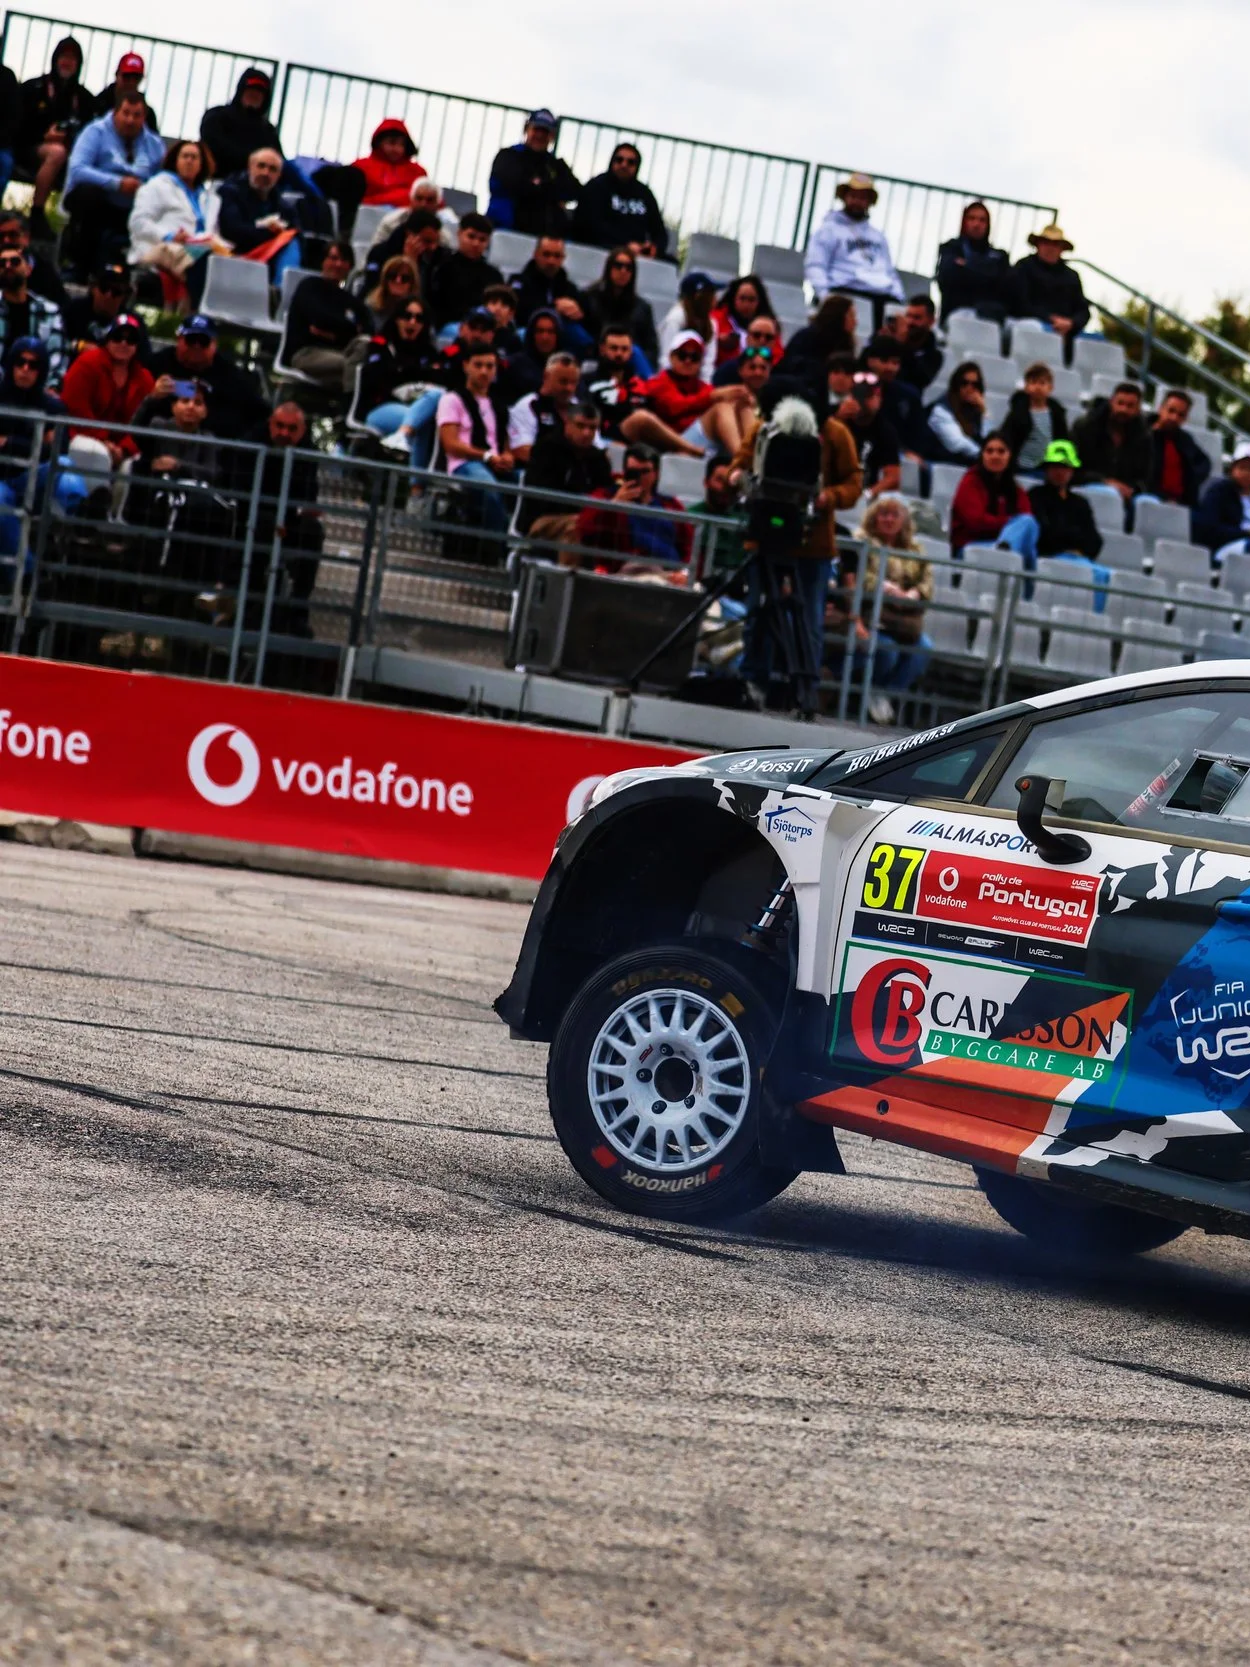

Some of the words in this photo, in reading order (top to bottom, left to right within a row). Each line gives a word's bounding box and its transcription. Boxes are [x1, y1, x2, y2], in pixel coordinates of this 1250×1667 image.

[754, 761, 793, 773] Forss
[793, 758, 815, 773] IT
[272, 756, 473, 816] vodafone
[772, 818, 813, 838] Sjötorps
[784, 833, 797, 843] Hus
[928, 824, 1040, 854] ALMASPOR
[863, 844, 925, 910] 37
[982, 873, 1007, 885] rally
[1009, 876, 1022, 885] de
[1071, 879, 1095, 888] WRC
[925, 893, 967, 909] vodafone
[978, 882, 1089, 918] Portugal
[878, 922, 915, 936] WRC2
[1062, 924, 1083, 935] 2026
[1214, 981, 1244, 996] FIA
[930, 991, 1115, 1055] CARSON
[931, 1035, 1056, 1070] BYGGARE
[1072, 1059, 1105, 1079] AB
